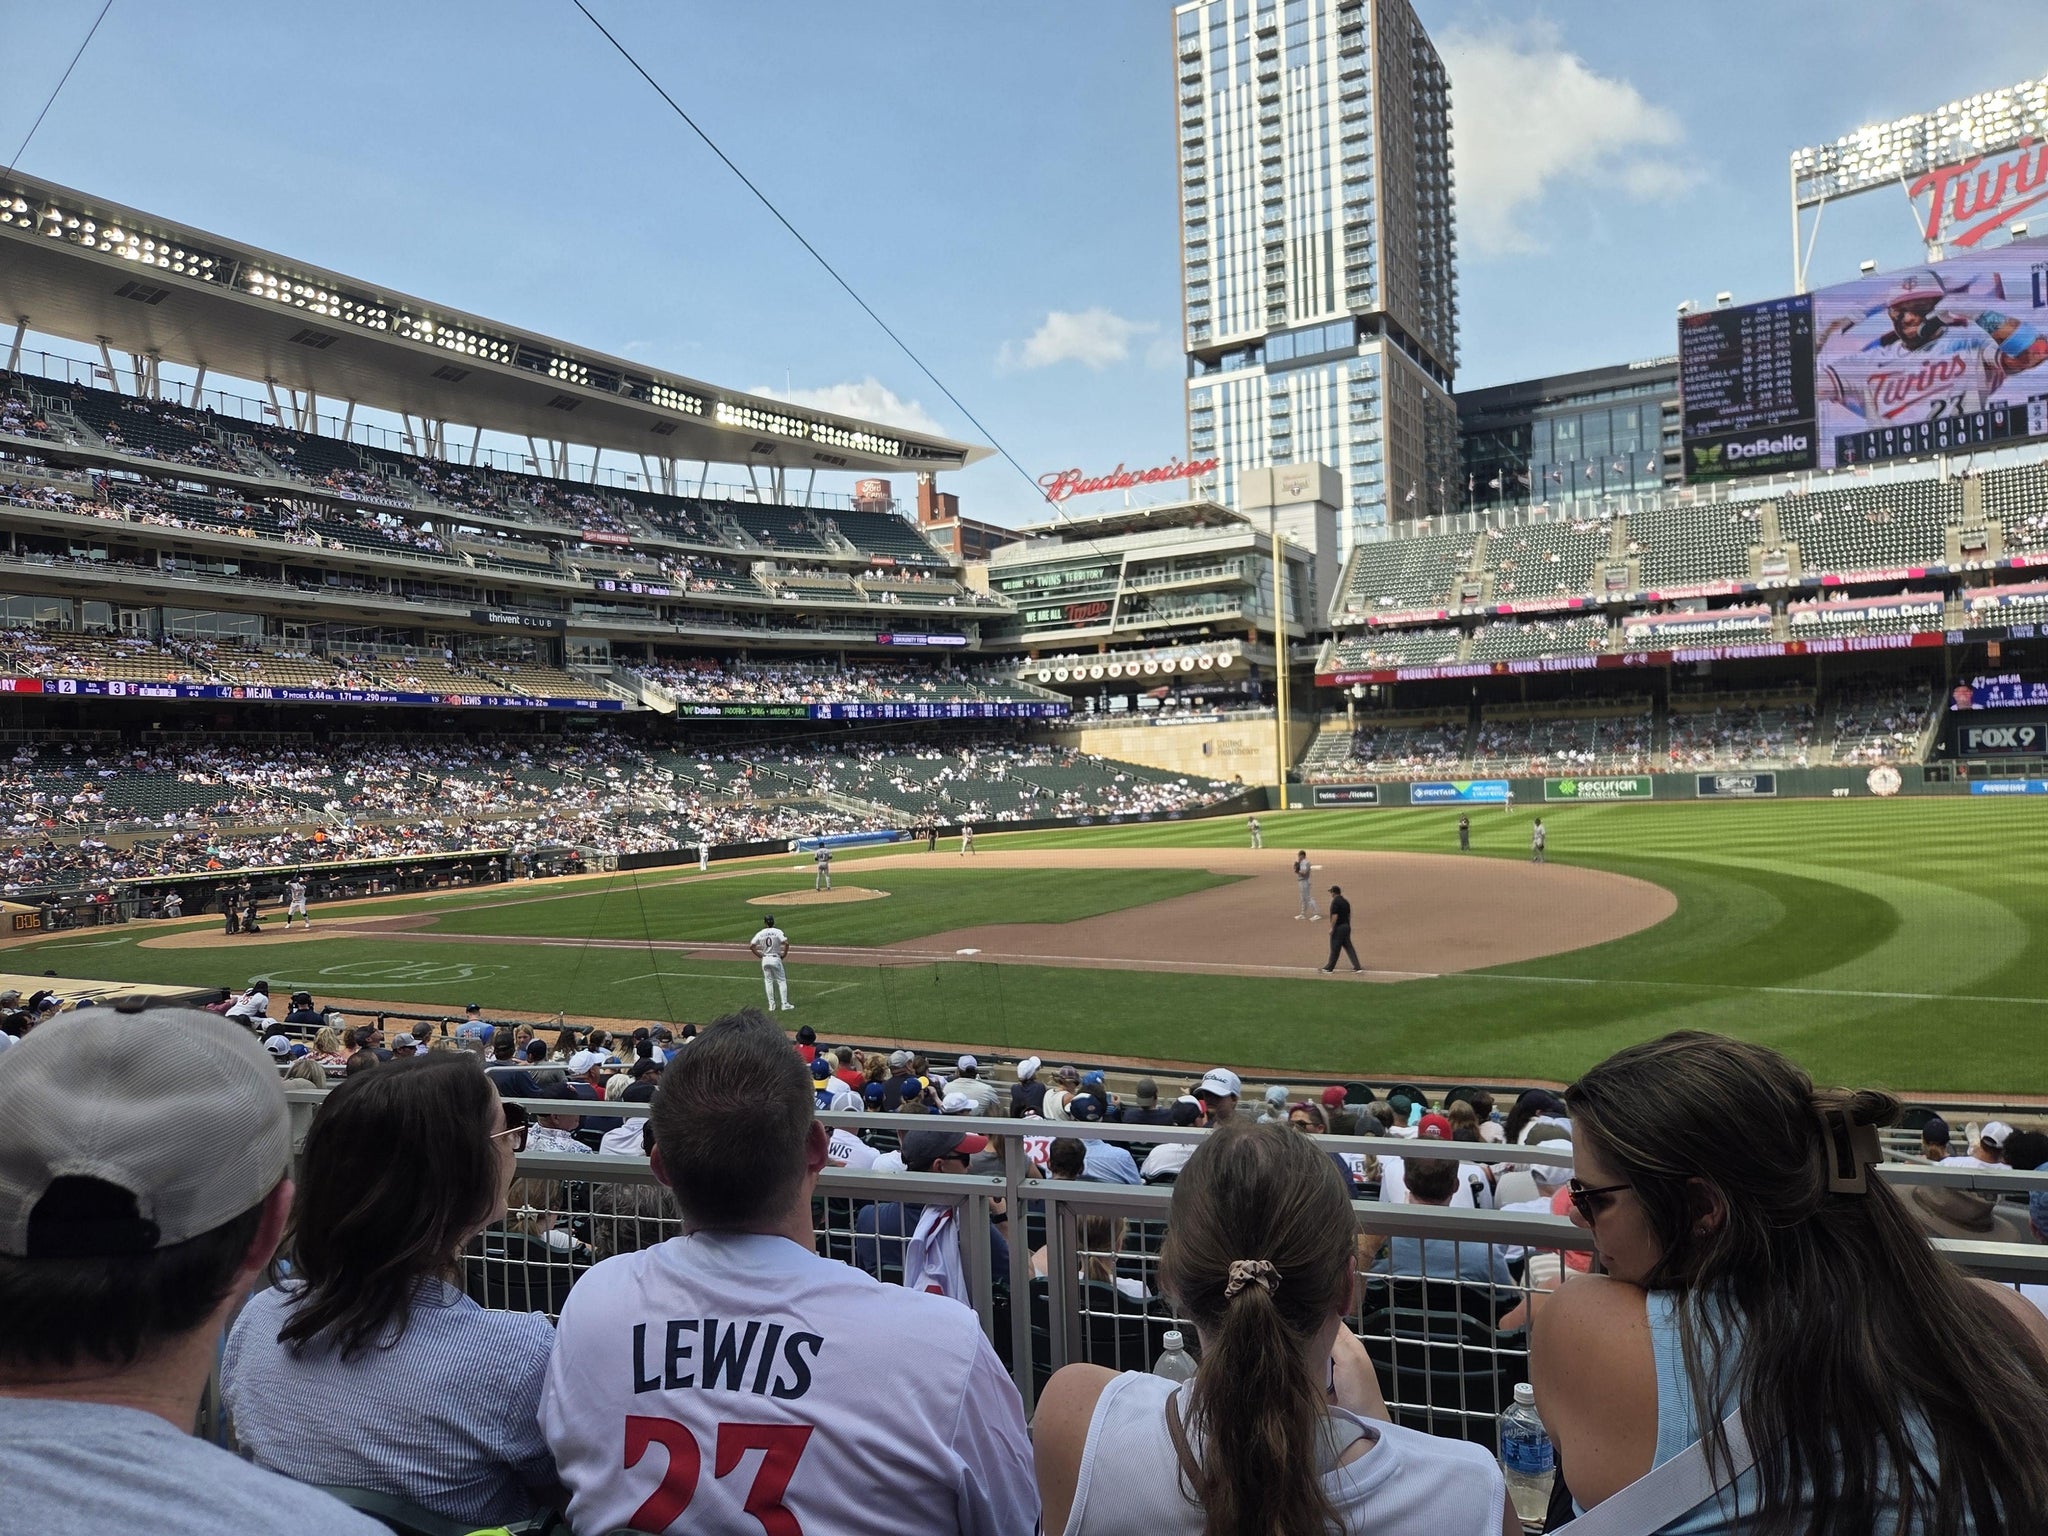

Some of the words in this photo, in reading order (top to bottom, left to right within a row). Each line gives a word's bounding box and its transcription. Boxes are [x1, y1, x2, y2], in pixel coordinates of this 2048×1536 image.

[1727, 434, 1807, 460] DaBella
[862, 480, 882, 492] Ford
[1038, 456, 1220, 502] Budweiser
[1037, 574, 1061, 587] TWINS
[1065, 568, 1104, 582] TERRITORY
[1658, 588, 1700, 600] Treasure
[1702, 584, 1732, 597] Island
[489, 613, 520, 624] thrivent
[524, 618, 552, 627] CLUB
[1026, 612, 1036, 622] WE
[1038, 610, 1050, 621] ARE
[1050, 609, 1062, 620] ALL
[1376, 613, 1412, 624] Treasure
[1414, 611, 1438, 622] Island
[1821, 610, 1865, 623] Home
[1868, 607, 1899, 620] Run
[1901, 603, 1938, 618] Deck
[1657, 620, 1714, 635] Treasure
[1717, 616, 1759, 631] Island
[1672, 649, 1722, 664] PROUDLY
[1725, 644, 1786, 659] POWERING
[1805, 639, 1844, 654] TWINS
[1849, 634, 1912, 651] TERRITORY
[1397, 667, 1438, 680] PROUDLY
[1440, 664, 1491, 677] POWERING
[1508, 660, 1540, 674] TWINS
[1543, 655, 1597, 672] TERRITORY
[0, 679, 16, 690] RY
[1972, 676, 1986, 689] 47
[1998, 674, 2021, 684] MEJIA
[222, 688, 232, 698] 47
[246, 688, 272, 699] MEJIA
[462, 696, 482, 705] LEWIS
[695, 706, 721, 715] DaBella
[1217, 739, 1242, 747] United
[1968, 728, 2018, 748] FOX
[2019, 727, 2035, 746] 9
[1218, 746, 1259, 756] Healthcare
[1578, 780, 1637, 794] securian
[829, 1142, 852, 1159] WIS
[633, 1319, 824, 1400] LEWIS
[624, 1414, 814, 1536] 23
